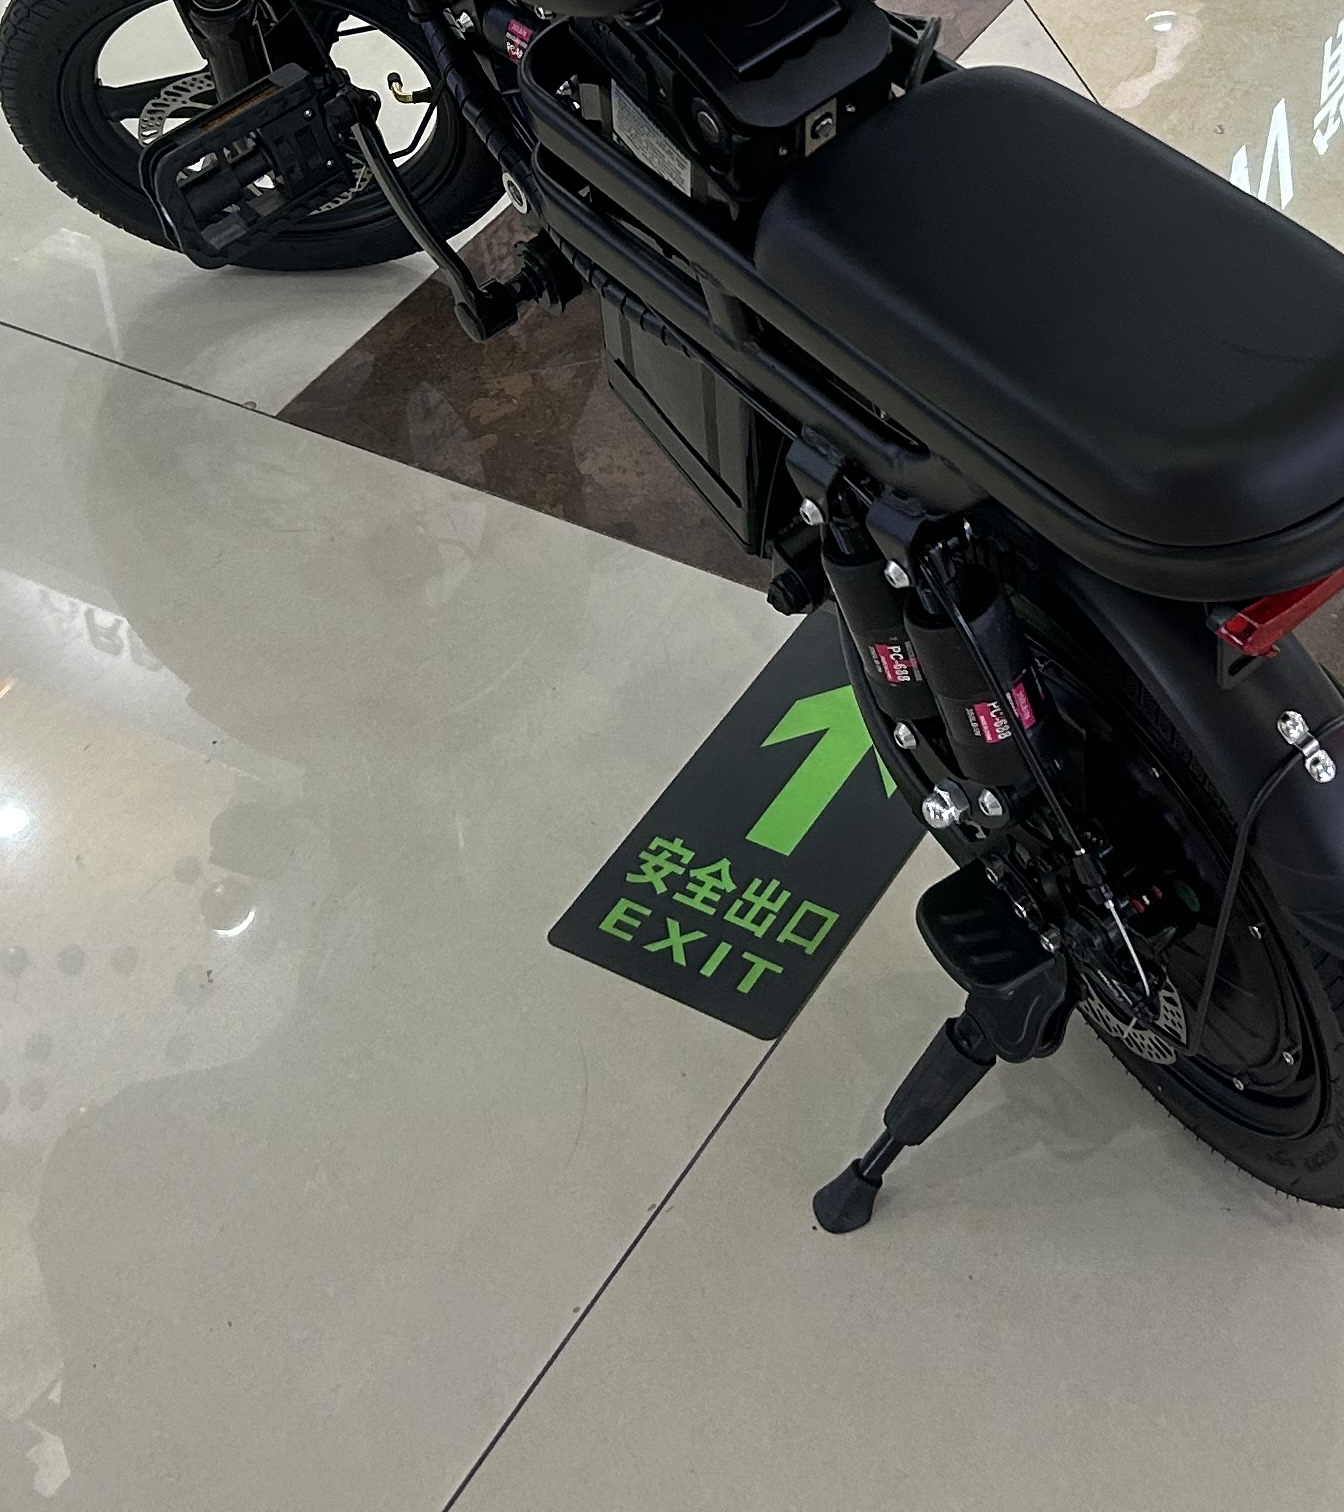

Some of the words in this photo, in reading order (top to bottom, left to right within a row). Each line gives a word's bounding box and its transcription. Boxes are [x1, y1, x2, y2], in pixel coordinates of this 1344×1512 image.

[886, 645, 911, 682] PC-688
[986, 700, 1013, 740] PC-688
[625, 836, 841, 955] 安全出口
[598, 897, 785, 995] EXIT
